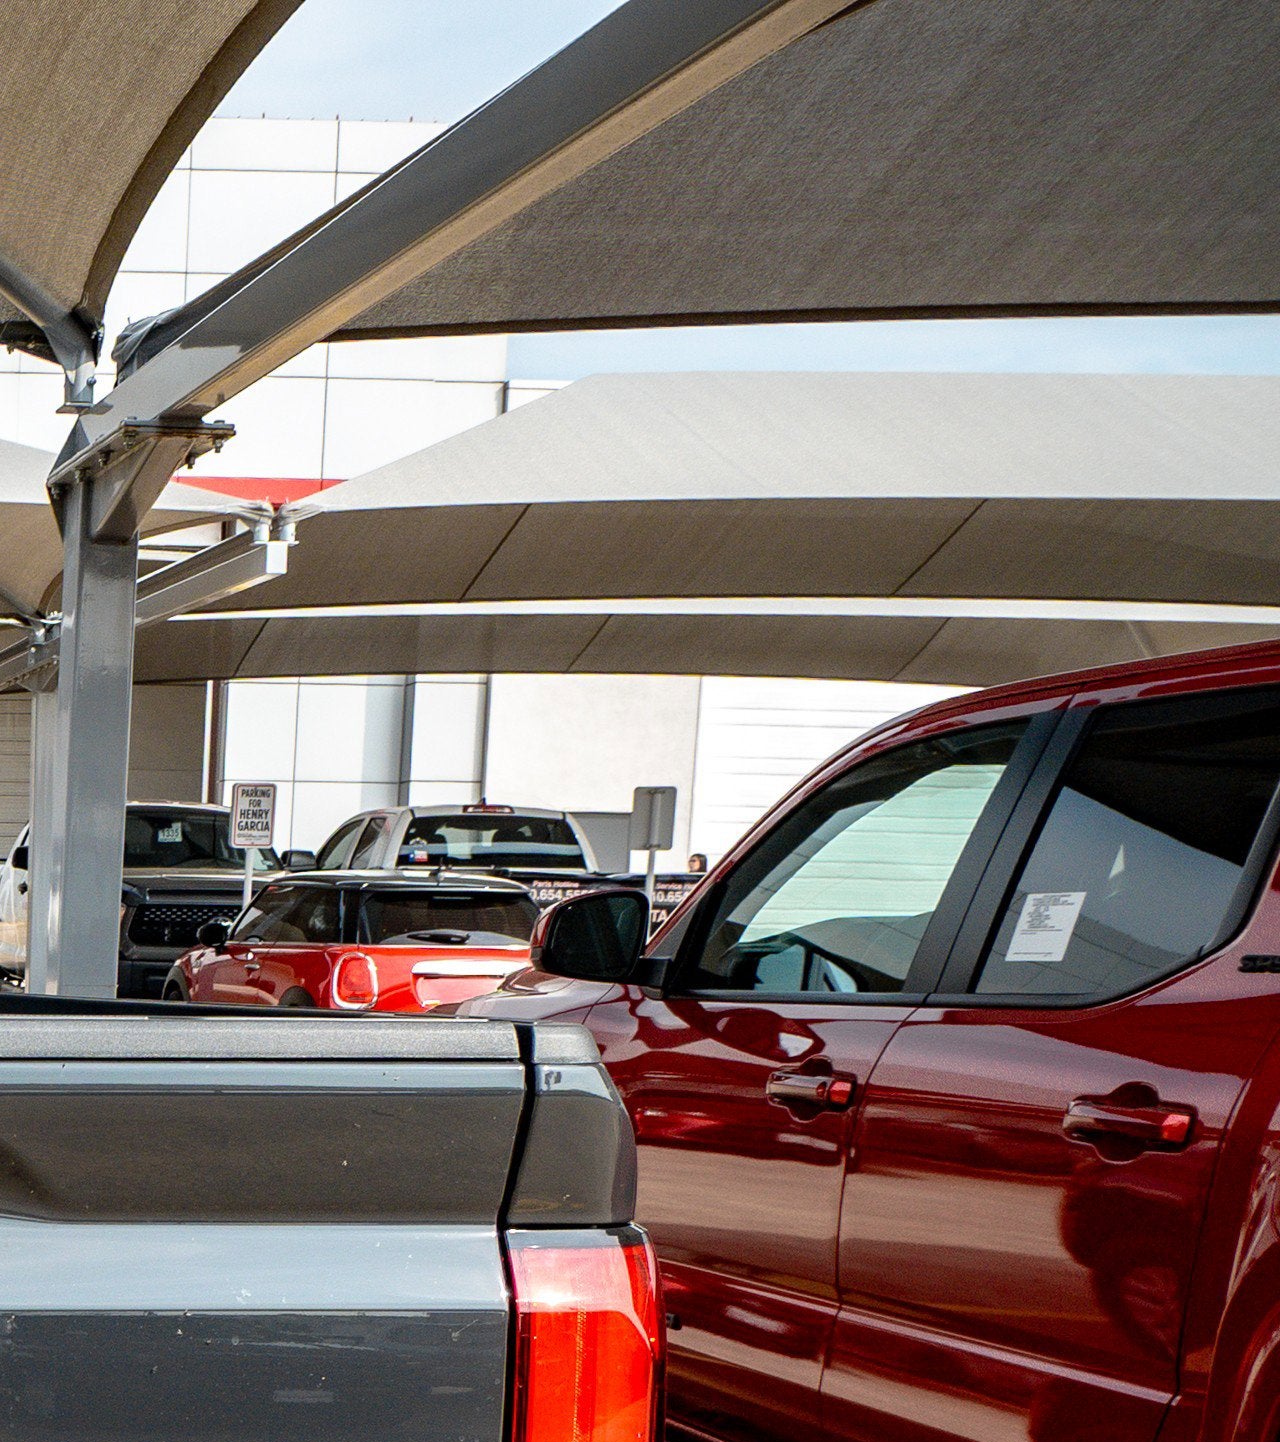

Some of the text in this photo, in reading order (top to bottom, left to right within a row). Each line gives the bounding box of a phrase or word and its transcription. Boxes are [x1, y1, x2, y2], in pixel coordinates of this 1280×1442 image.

[241, 788, 271, 798] PARKING
[248, 799, 262, 808] FOR
[239, 809, 270, 820] HENRY
[237, 821, 270, 832] GARCIA
